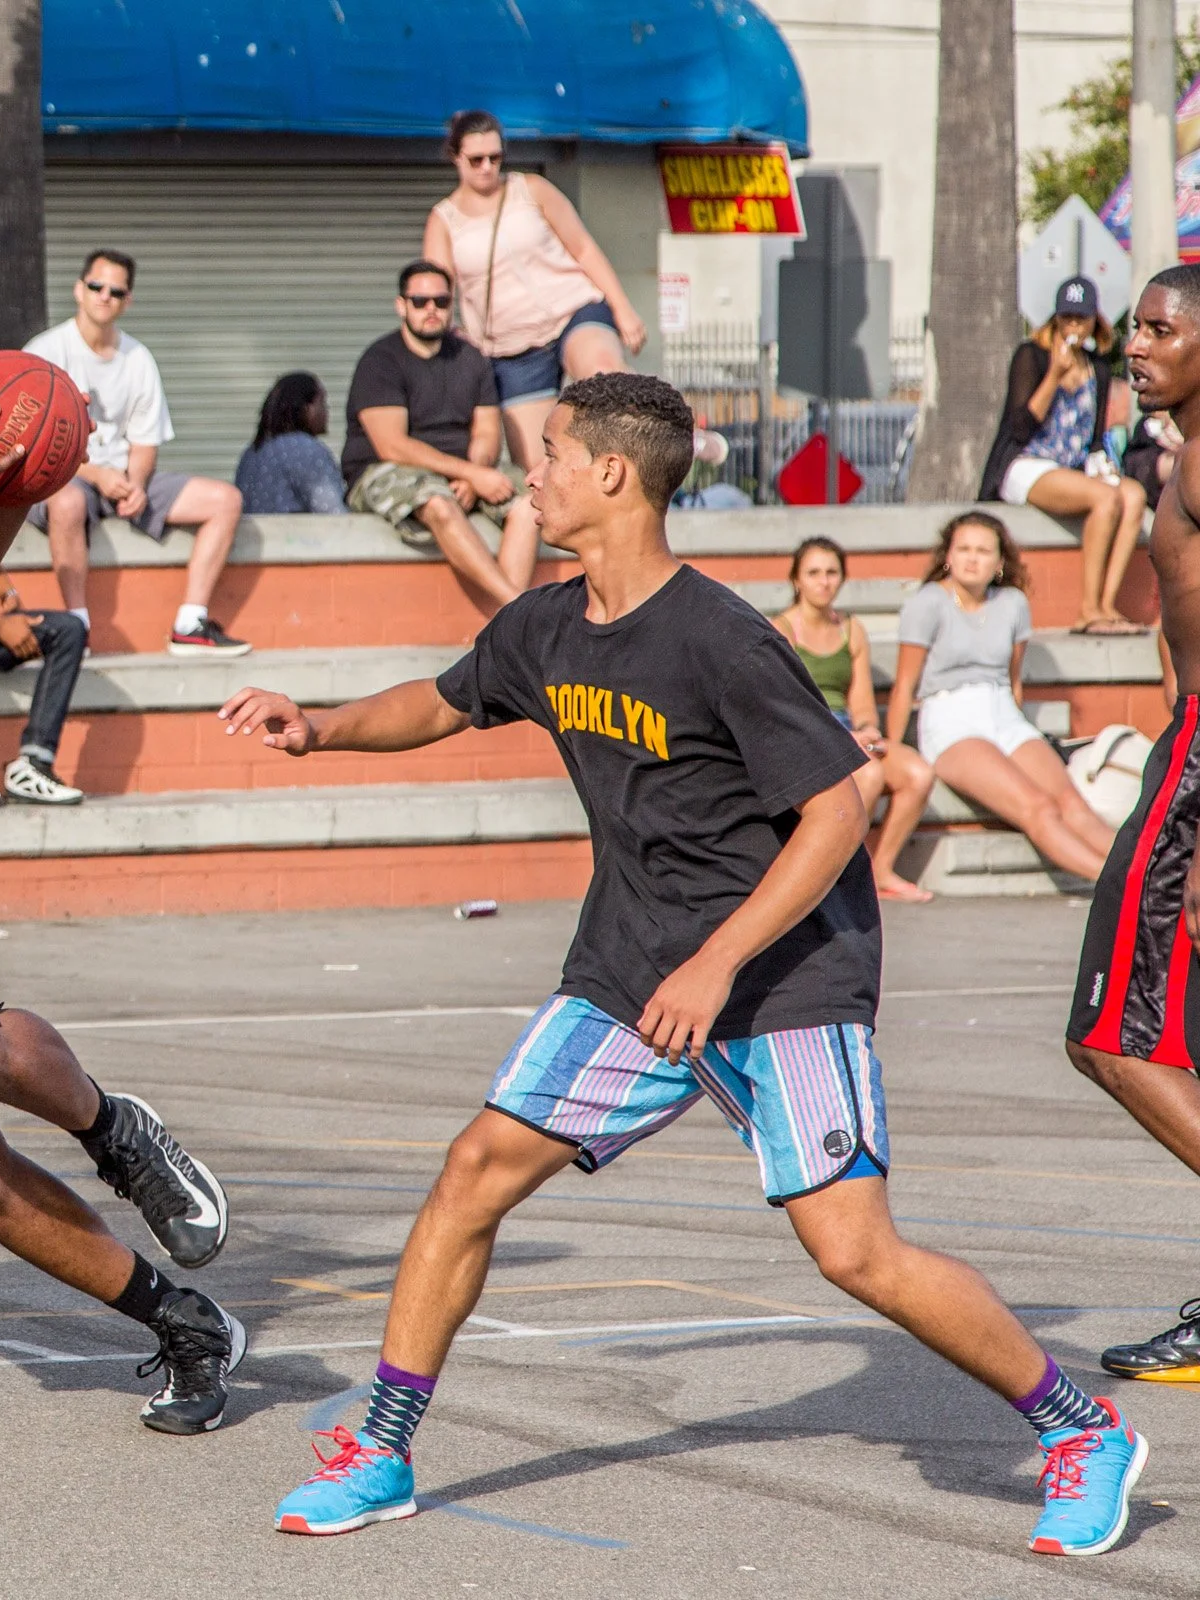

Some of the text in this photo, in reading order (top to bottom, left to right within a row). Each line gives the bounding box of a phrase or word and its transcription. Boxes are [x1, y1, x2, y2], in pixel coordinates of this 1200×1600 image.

[664, 155, 791, 198] SUNGLASSES
[690, 199, 778, 232] CLIP-ON
[545, 684, 670, 761] OOKLYN
[1089, 971, 1105, 1008] Reebok
